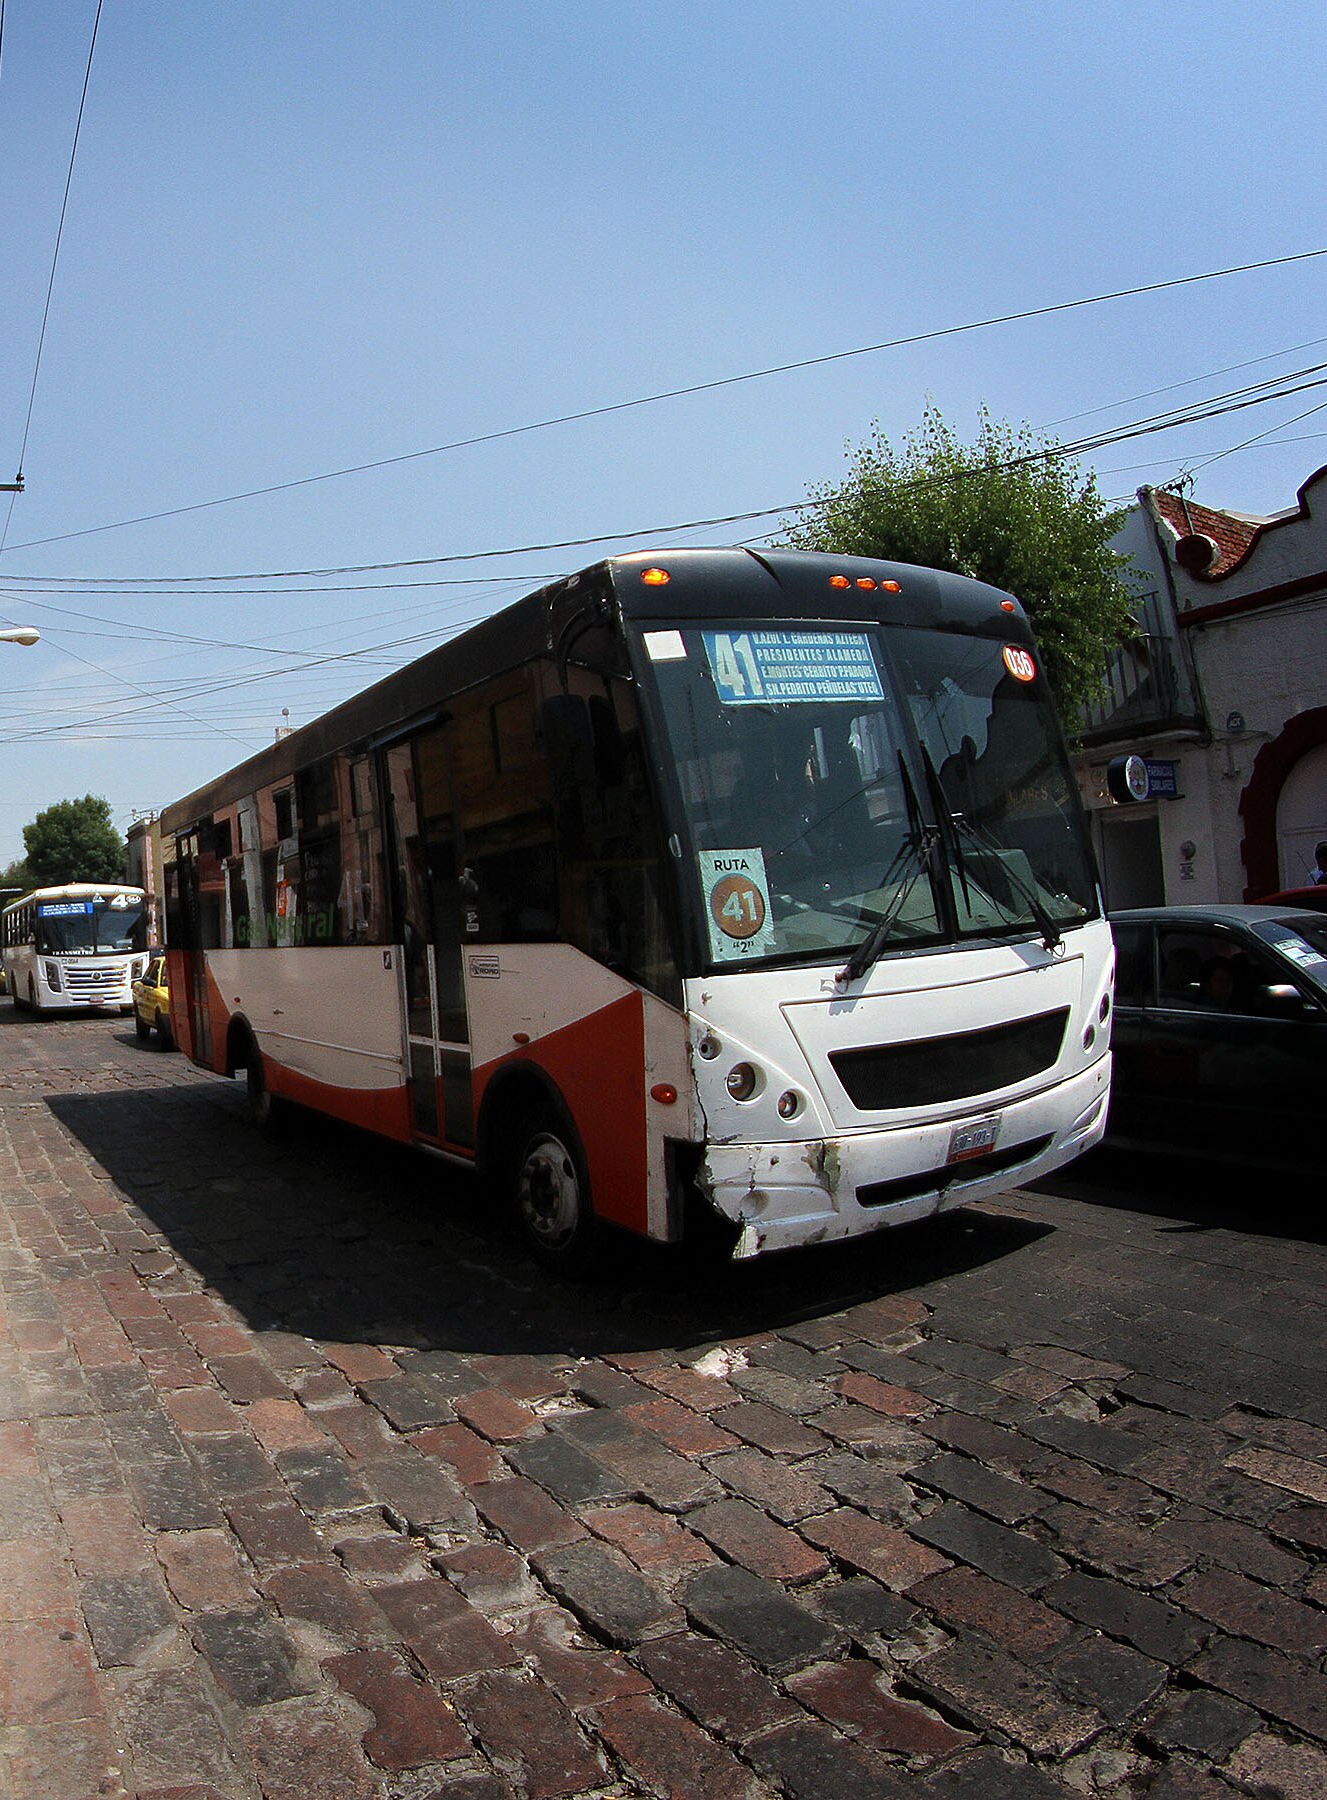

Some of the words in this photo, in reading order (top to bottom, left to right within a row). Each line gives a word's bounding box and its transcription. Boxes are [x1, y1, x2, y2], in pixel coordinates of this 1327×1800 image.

[715, 634, 764, 697] 41
[1005, 647, 1033, 677] 036
[714, 859, 750, 872] RUTA
[110, 893, 129, 908] 4
[722, 889, 757, 921] 41
